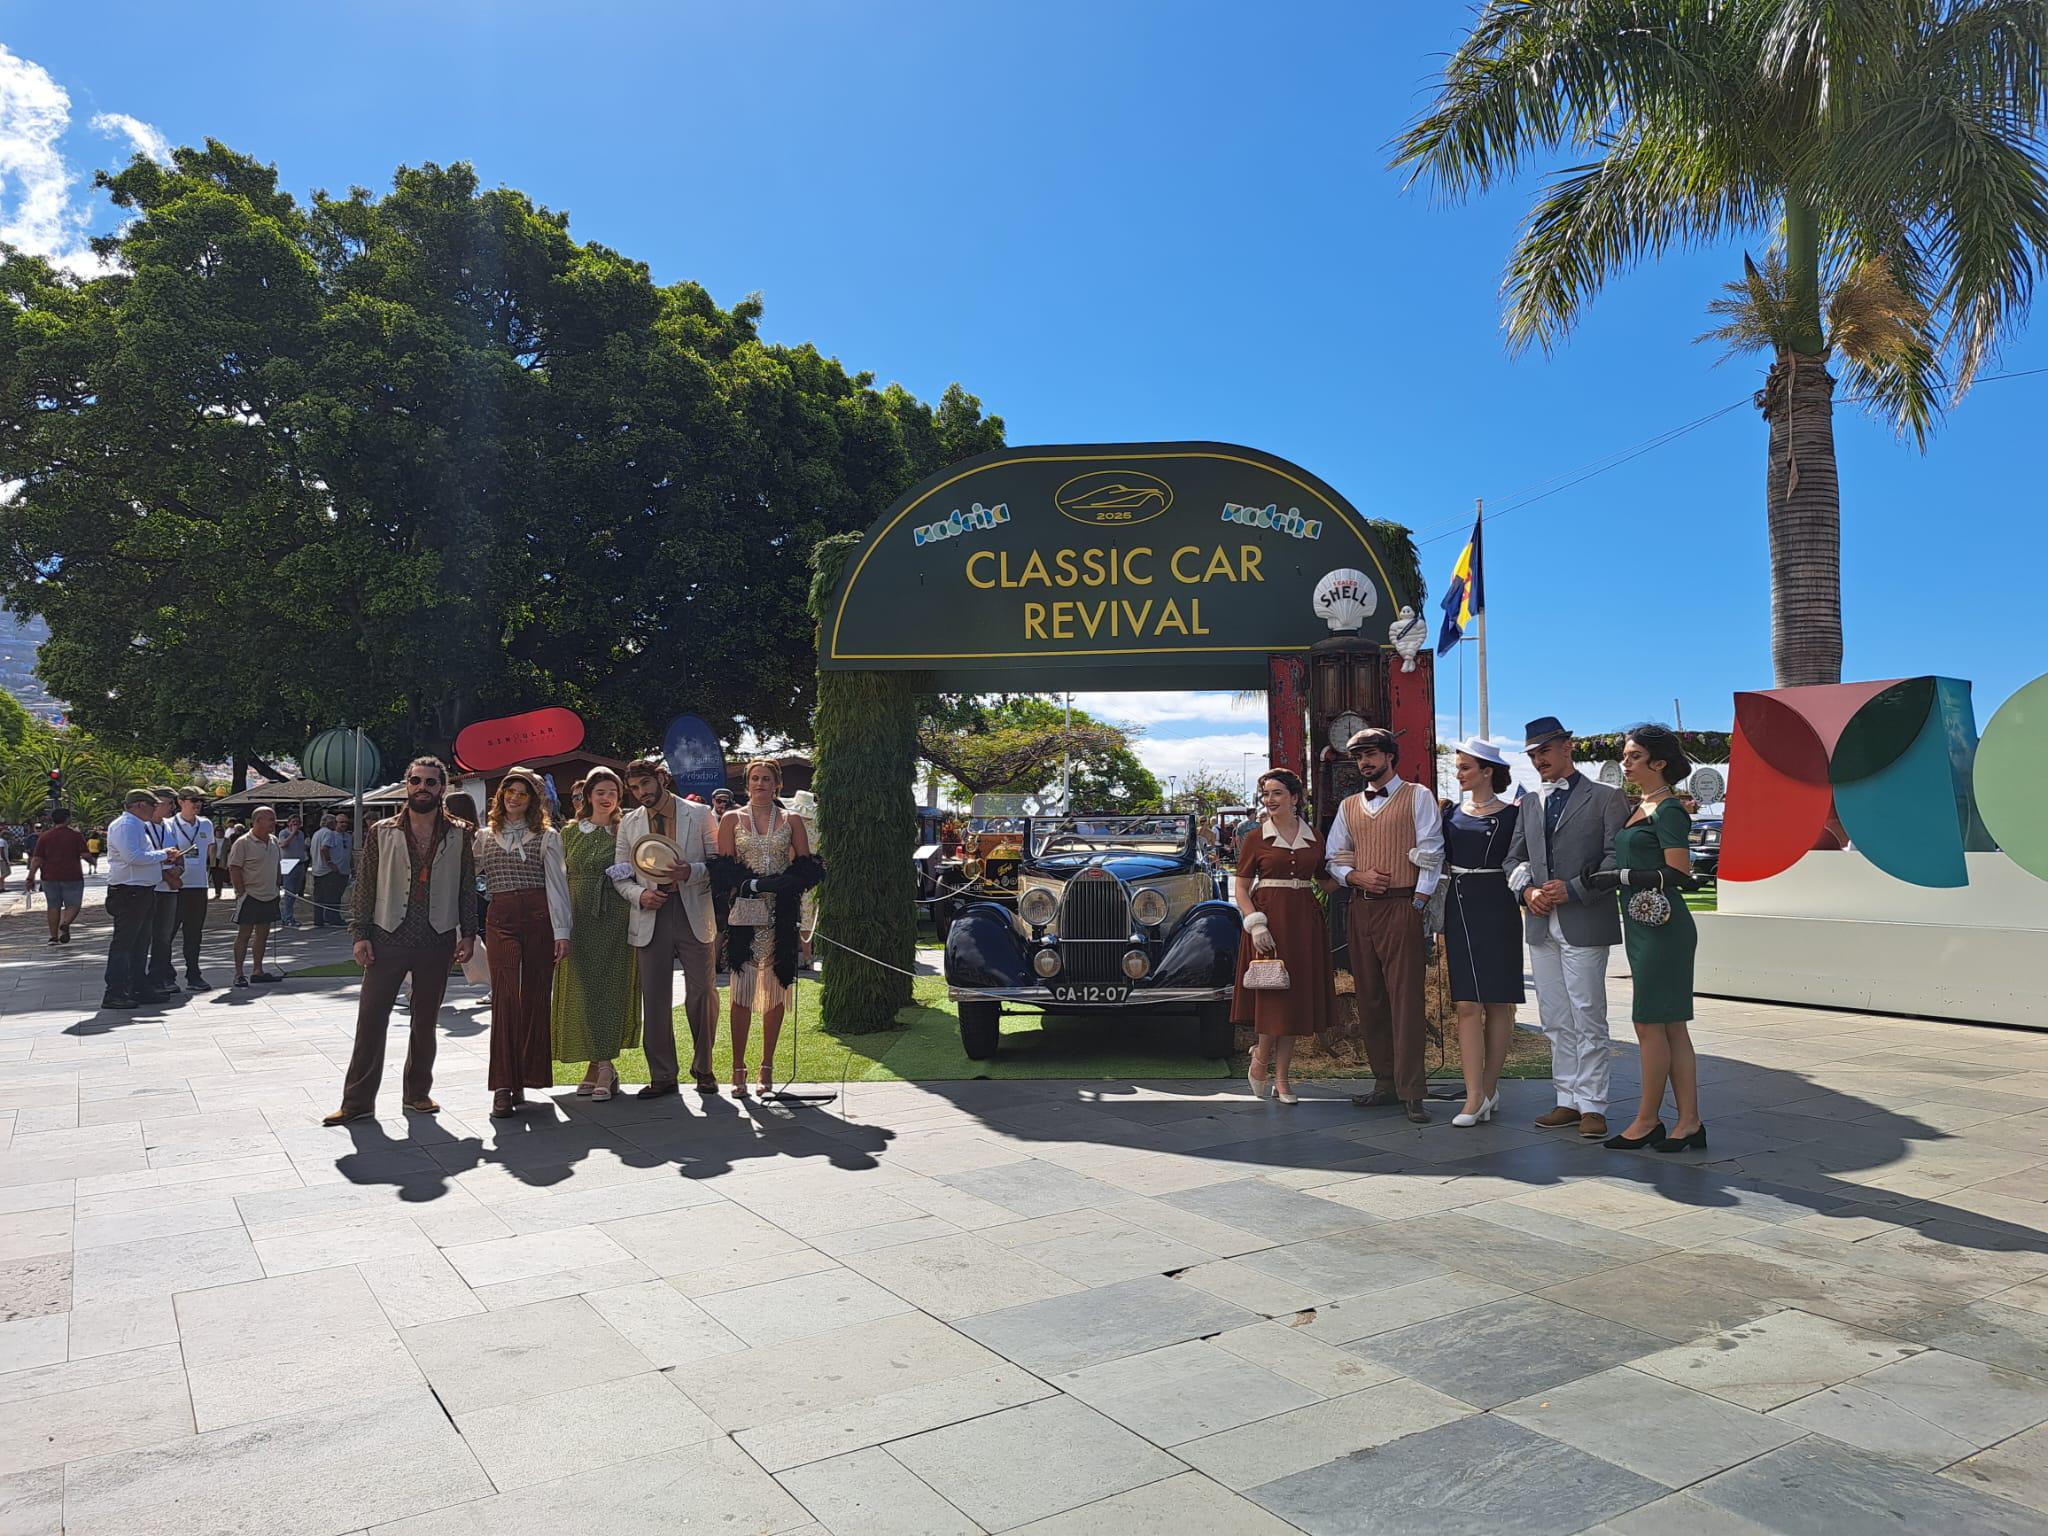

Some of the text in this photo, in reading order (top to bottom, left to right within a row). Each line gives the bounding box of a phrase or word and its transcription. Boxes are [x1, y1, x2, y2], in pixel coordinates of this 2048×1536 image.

[1097, 512, 1132, 521] 2025
[966, 545, 1264, 589] CLASSIC CAR
[1320, 586, 1368, 608] SHELL
[1024, 599, 1210, 640] REVIVAL
[1056, 987, 1127, 1001] CA-12-07
